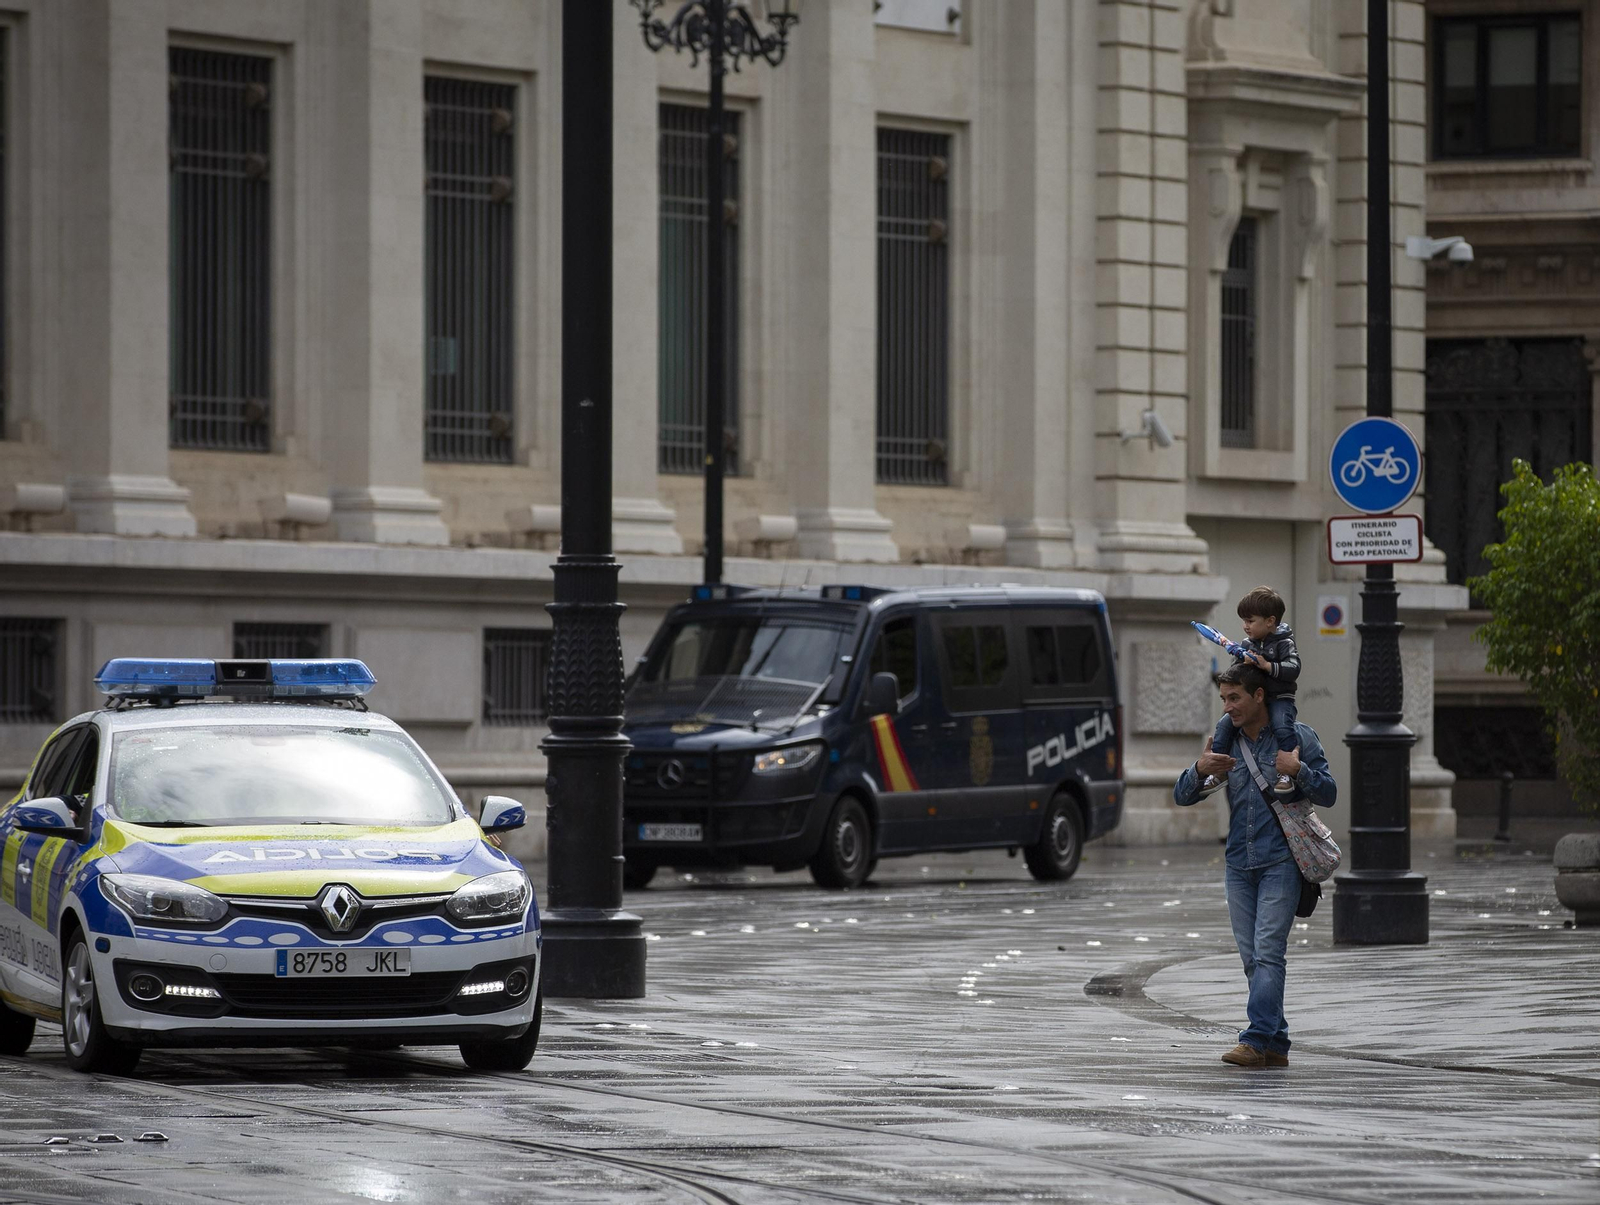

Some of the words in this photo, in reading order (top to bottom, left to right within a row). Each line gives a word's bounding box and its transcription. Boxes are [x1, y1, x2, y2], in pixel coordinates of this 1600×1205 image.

[1351, 521, 1397, 529] ITINERARIO
[1367, 548, 1408, 556] PEATONAL
[1026, 709, 1115, 777] POLICÍA
[293, 952, 347, 973] 8758
[366, 951, 406, 973] JKL
